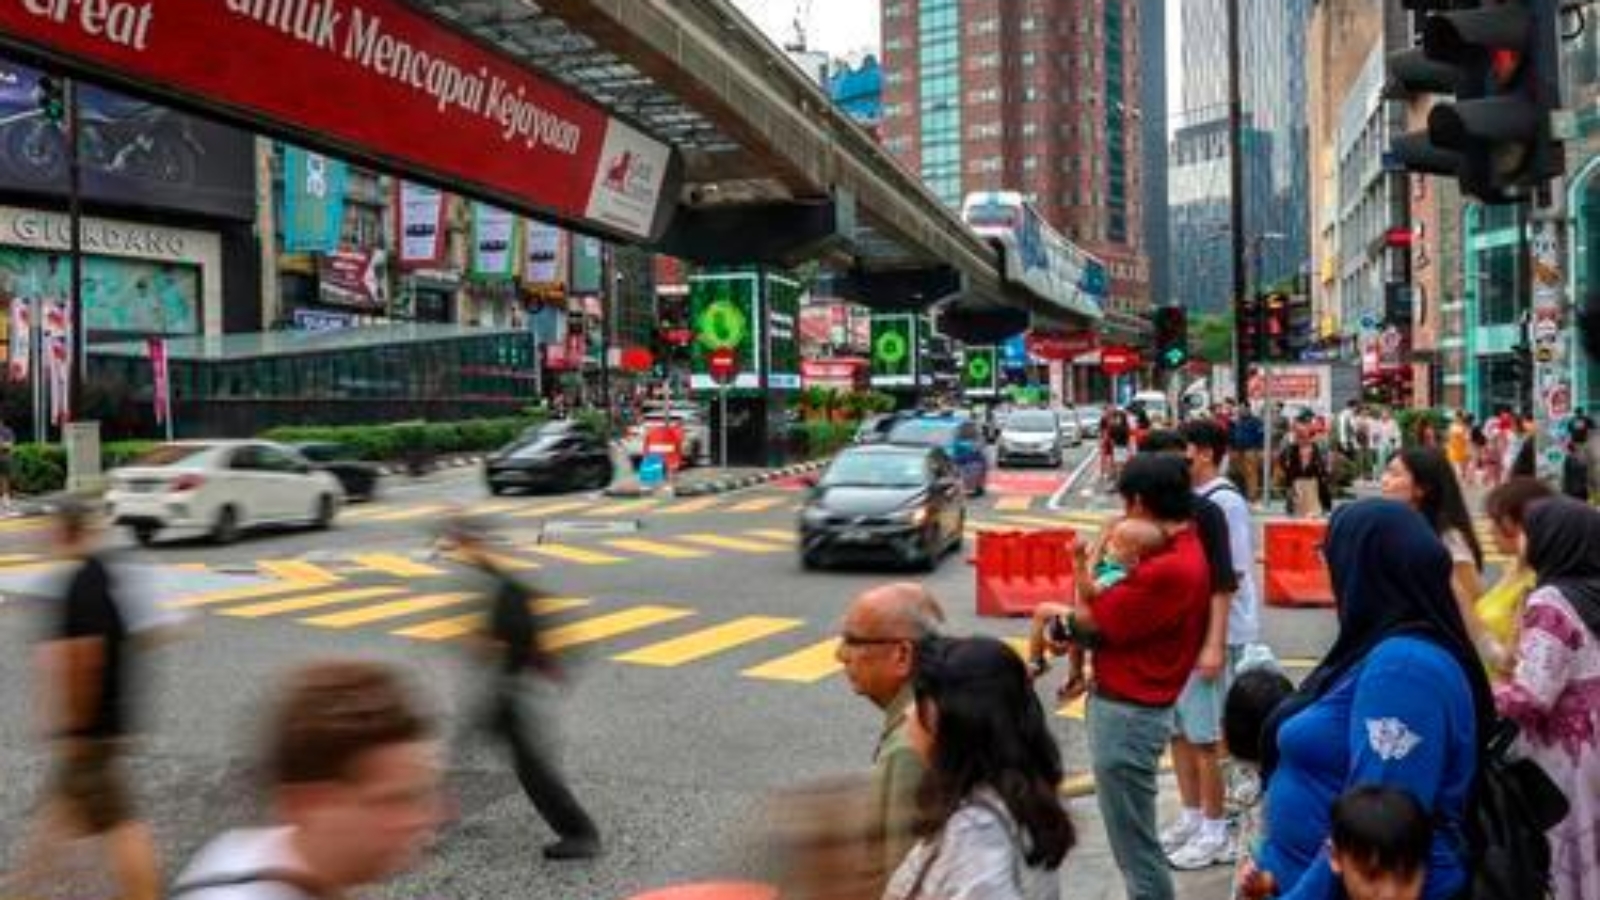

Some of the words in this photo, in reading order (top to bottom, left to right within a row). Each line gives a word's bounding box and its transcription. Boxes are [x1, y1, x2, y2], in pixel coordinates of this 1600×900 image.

[22, 0, 153, 51] reat
[344, 7, 488, 113] Mencapai
[13, 212, 185, 255] GIORDANO
